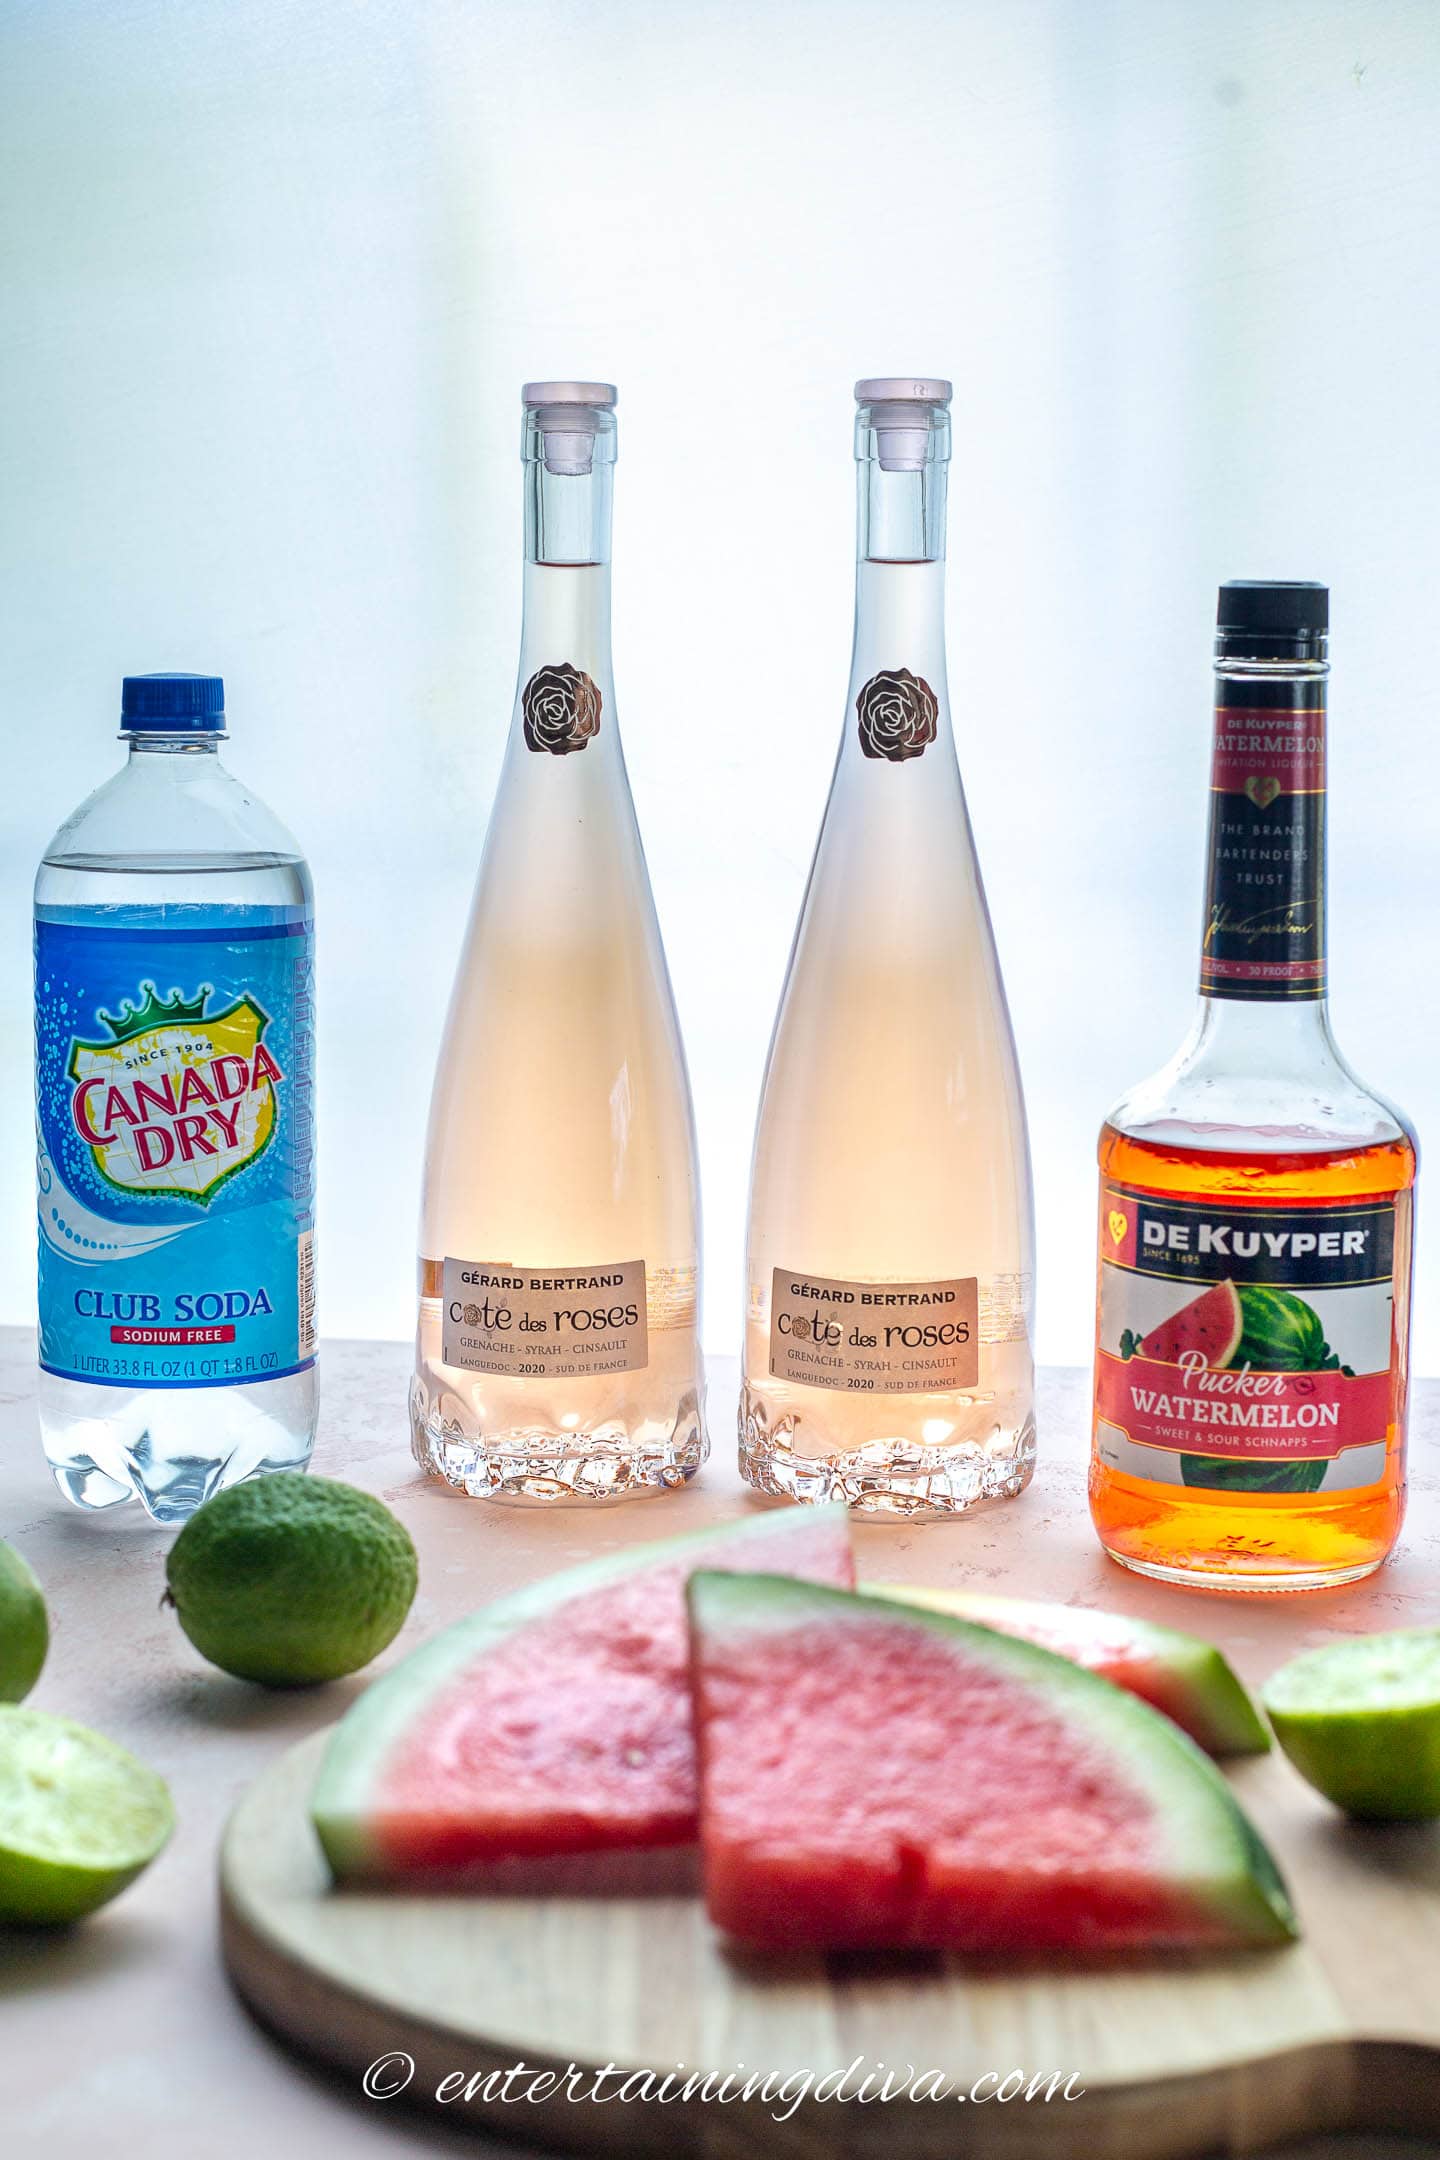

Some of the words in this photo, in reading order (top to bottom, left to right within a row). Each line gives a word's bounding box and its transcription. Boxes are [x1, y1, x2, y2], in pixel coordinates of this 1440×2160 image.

[1228, 720, 1242, 729] DE
[1213, 735, 1325, 753] ATERMELON
[1220, 824, 1243, 834] THE
[1252, 825, 1305, 836] BRAND
[1216, 848, 1309, 862] BARTENDERS
[1236, 872, 1285, 885] TRUST
[1263, 967, 1295, 977] PROOF
[125, 1048, 168, 1070] SINCE
[175, 1042, 213, 1054] 1904
[72, 1043, 283, 1146] CANADA
[134, 1101, 241, 1172] DRY
[1143, 1219, 1190, 1250] DE
[1142, 1247, 1170, 1261] SINCE
[460, 1270, 524, 1290] GÉRARD
[530, 1274, 624, 1291] BERTRAND
[74, 1289, 161, 1322] CLUB
[174, 1288, 273, 1323] SODA
[790, 1282, 855, 1304] GÉRARD
[861, 1291, 956, 1306] BERTRAND
[518, 1312, 547, 1332] des
[554, 1303, 639, 1332] roses
[123, 1328, 181, 1343] SODIUM
[187, 1329, 222, 1342] FREE
[848, 1326, 877, 1348] des
[884, 1320, 970, 1347] roses
[460, 1337, 516, 1355] GRENACHE
[524, 1345, 562, 1356] SYRAH
[572, 1339, 628, 1354] CINSAULT
[72, 1354, 79, 1369] 1
[80, 1355, 109, 1375] LITER
[112, 1359, 140, 1377] 33.8
[143, 1361, 158, 1377] FL
[162, 1361, 181, 1378] OZ
[184, 1361, 197, 1379] (1
[200, 1360, 219, 1377] QT
[224, 1356, 243, 1375] 1.8
[245, 1354, 259, 1372] FL
[260, 1351, 279, 1370] OZ)
[460, 1356, 511, 1372] LANGUEDOC
[518, 1363, 546, 1374] 2020
[555, 1365, 577, 1374] SUD
[593, 1359, 628, 1371] FRANCE
[787, 1348, 844, 1368] GRENACHE
[853, 1360, 891, 1371] SYRAH
[902, 1357, 958, 1371] CINSAULT
[787, 1368, 839, 1386] LANGUEDOC
[847, 1378, 874, 1390] 2020
[884, 1381, 905, 1390] SUD
[922, 1377, 957, 1388] FRANCE
[1178, 1350, 1289, 1397] Pucker
[1130, 1387, 1341, 1428] WATERMELON
[1155, 1425, 1190, 1441] SWEET
[1195, 1430, 1203, 1442] &
[1207, 1433, 1240, 1446] SOUR
[1245, 1436, 1308, 1448] SCHNAPPS
